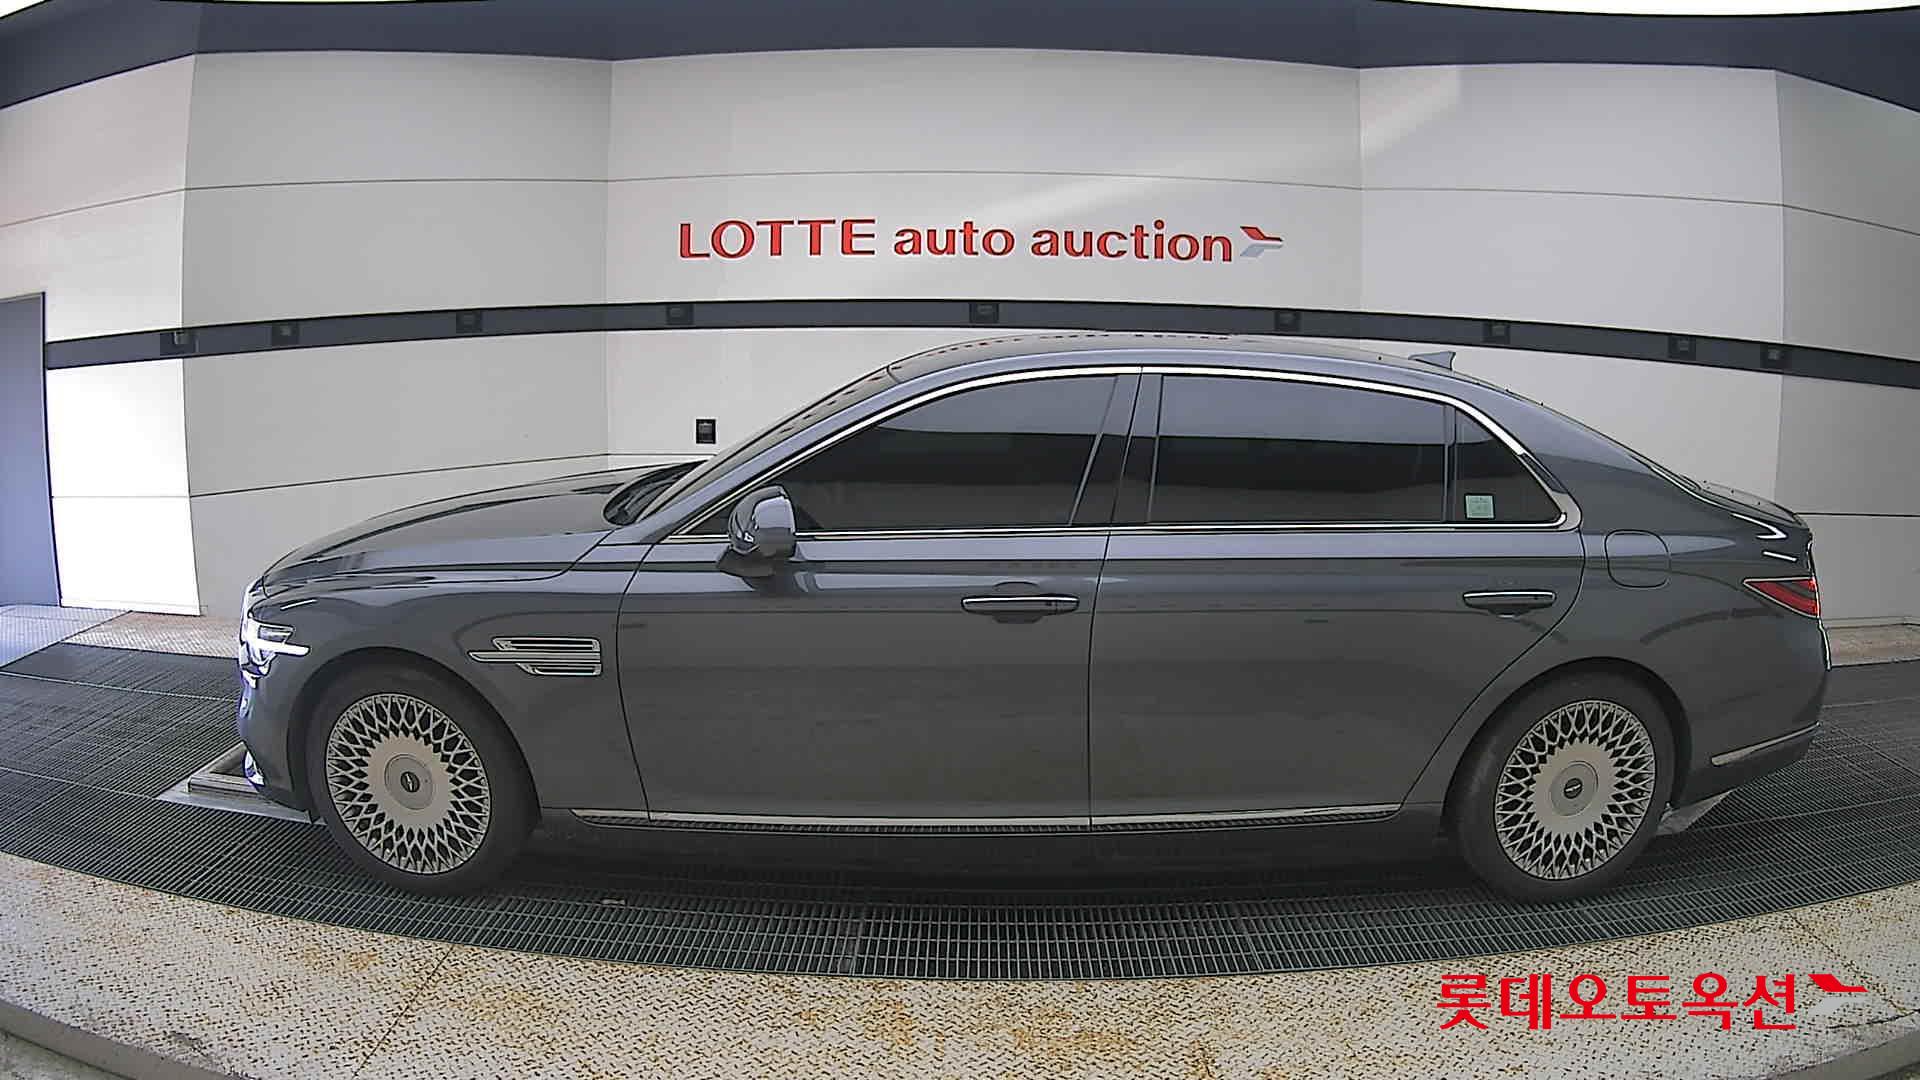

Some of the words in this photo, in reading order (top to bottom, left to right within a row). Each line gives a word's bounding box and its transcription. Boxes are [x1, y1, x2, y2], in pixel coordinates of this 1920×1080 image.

[680, 219, 875, 259] LOTTE
[894, 221, 1015, 257] auto
[1032, 220, 1232, 262] auction
